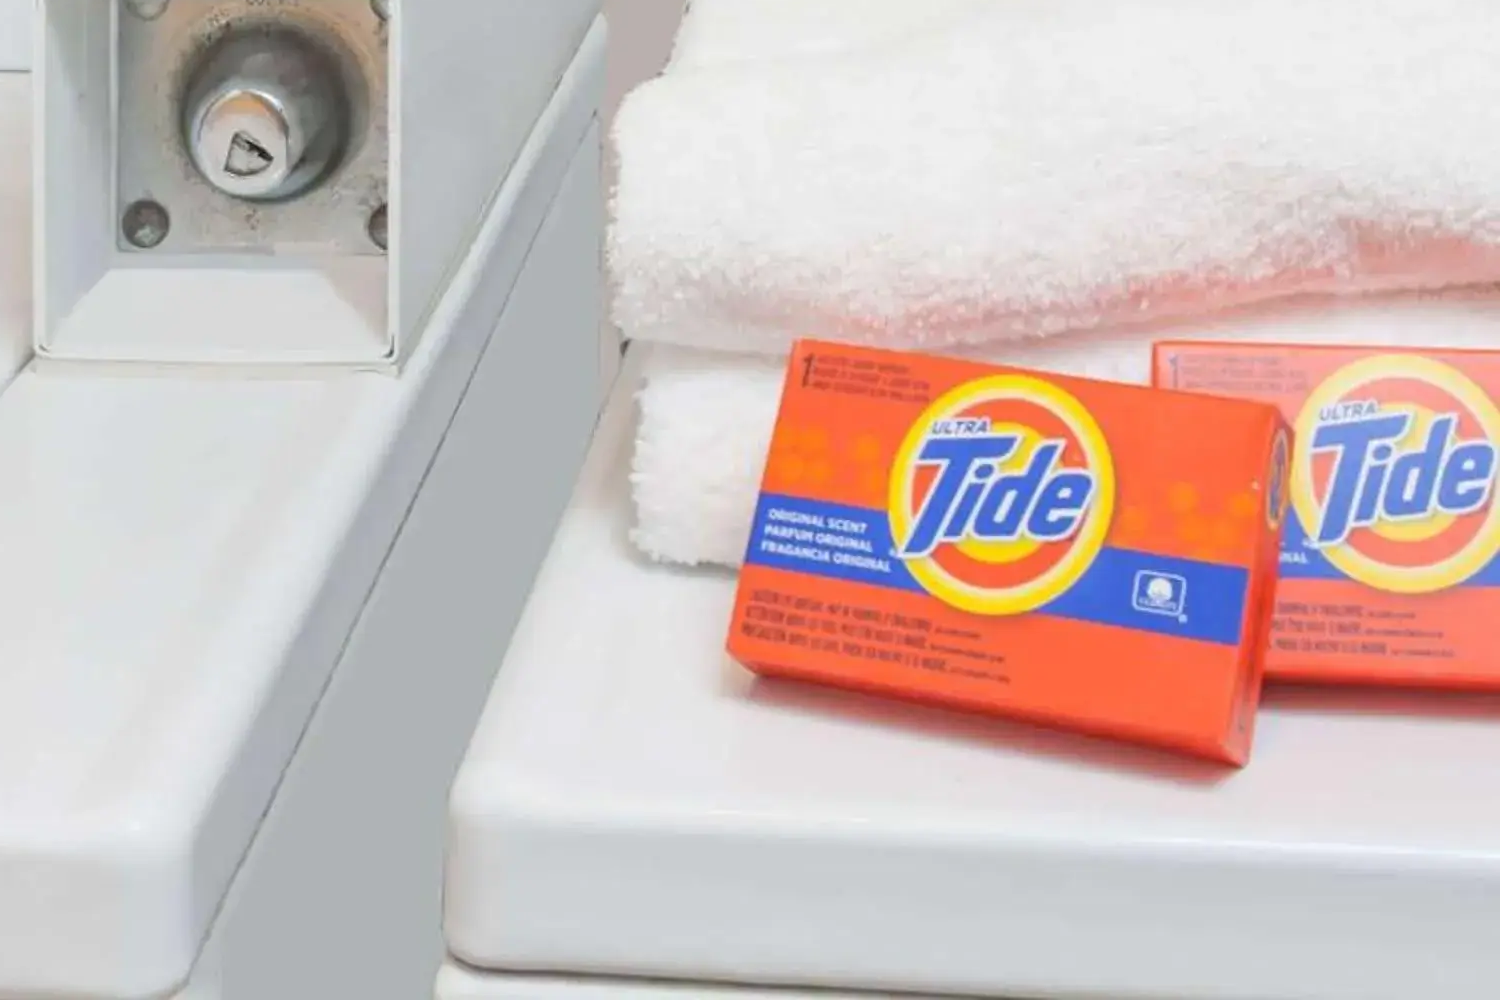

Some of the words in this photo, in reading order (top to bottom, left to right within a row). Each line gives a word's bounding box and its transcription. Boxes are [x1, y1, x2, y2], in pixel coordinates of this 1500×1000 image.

[1319, 402, 1377, 421] ULTRA
[932, 420, 988, 434] ULTRA
[1311, 412, 1495, 545] Tide
[900, 435, 1094, 556] Tide
[768, 508, 824, 528] ORIGINAL
[827, 517, 868, 534] SCENT
[764, 524, 813, 542] PARFUM
[815, 532, 873, 553] ORIGINAL
[833, 551, 891, 573] ORIGINAL
